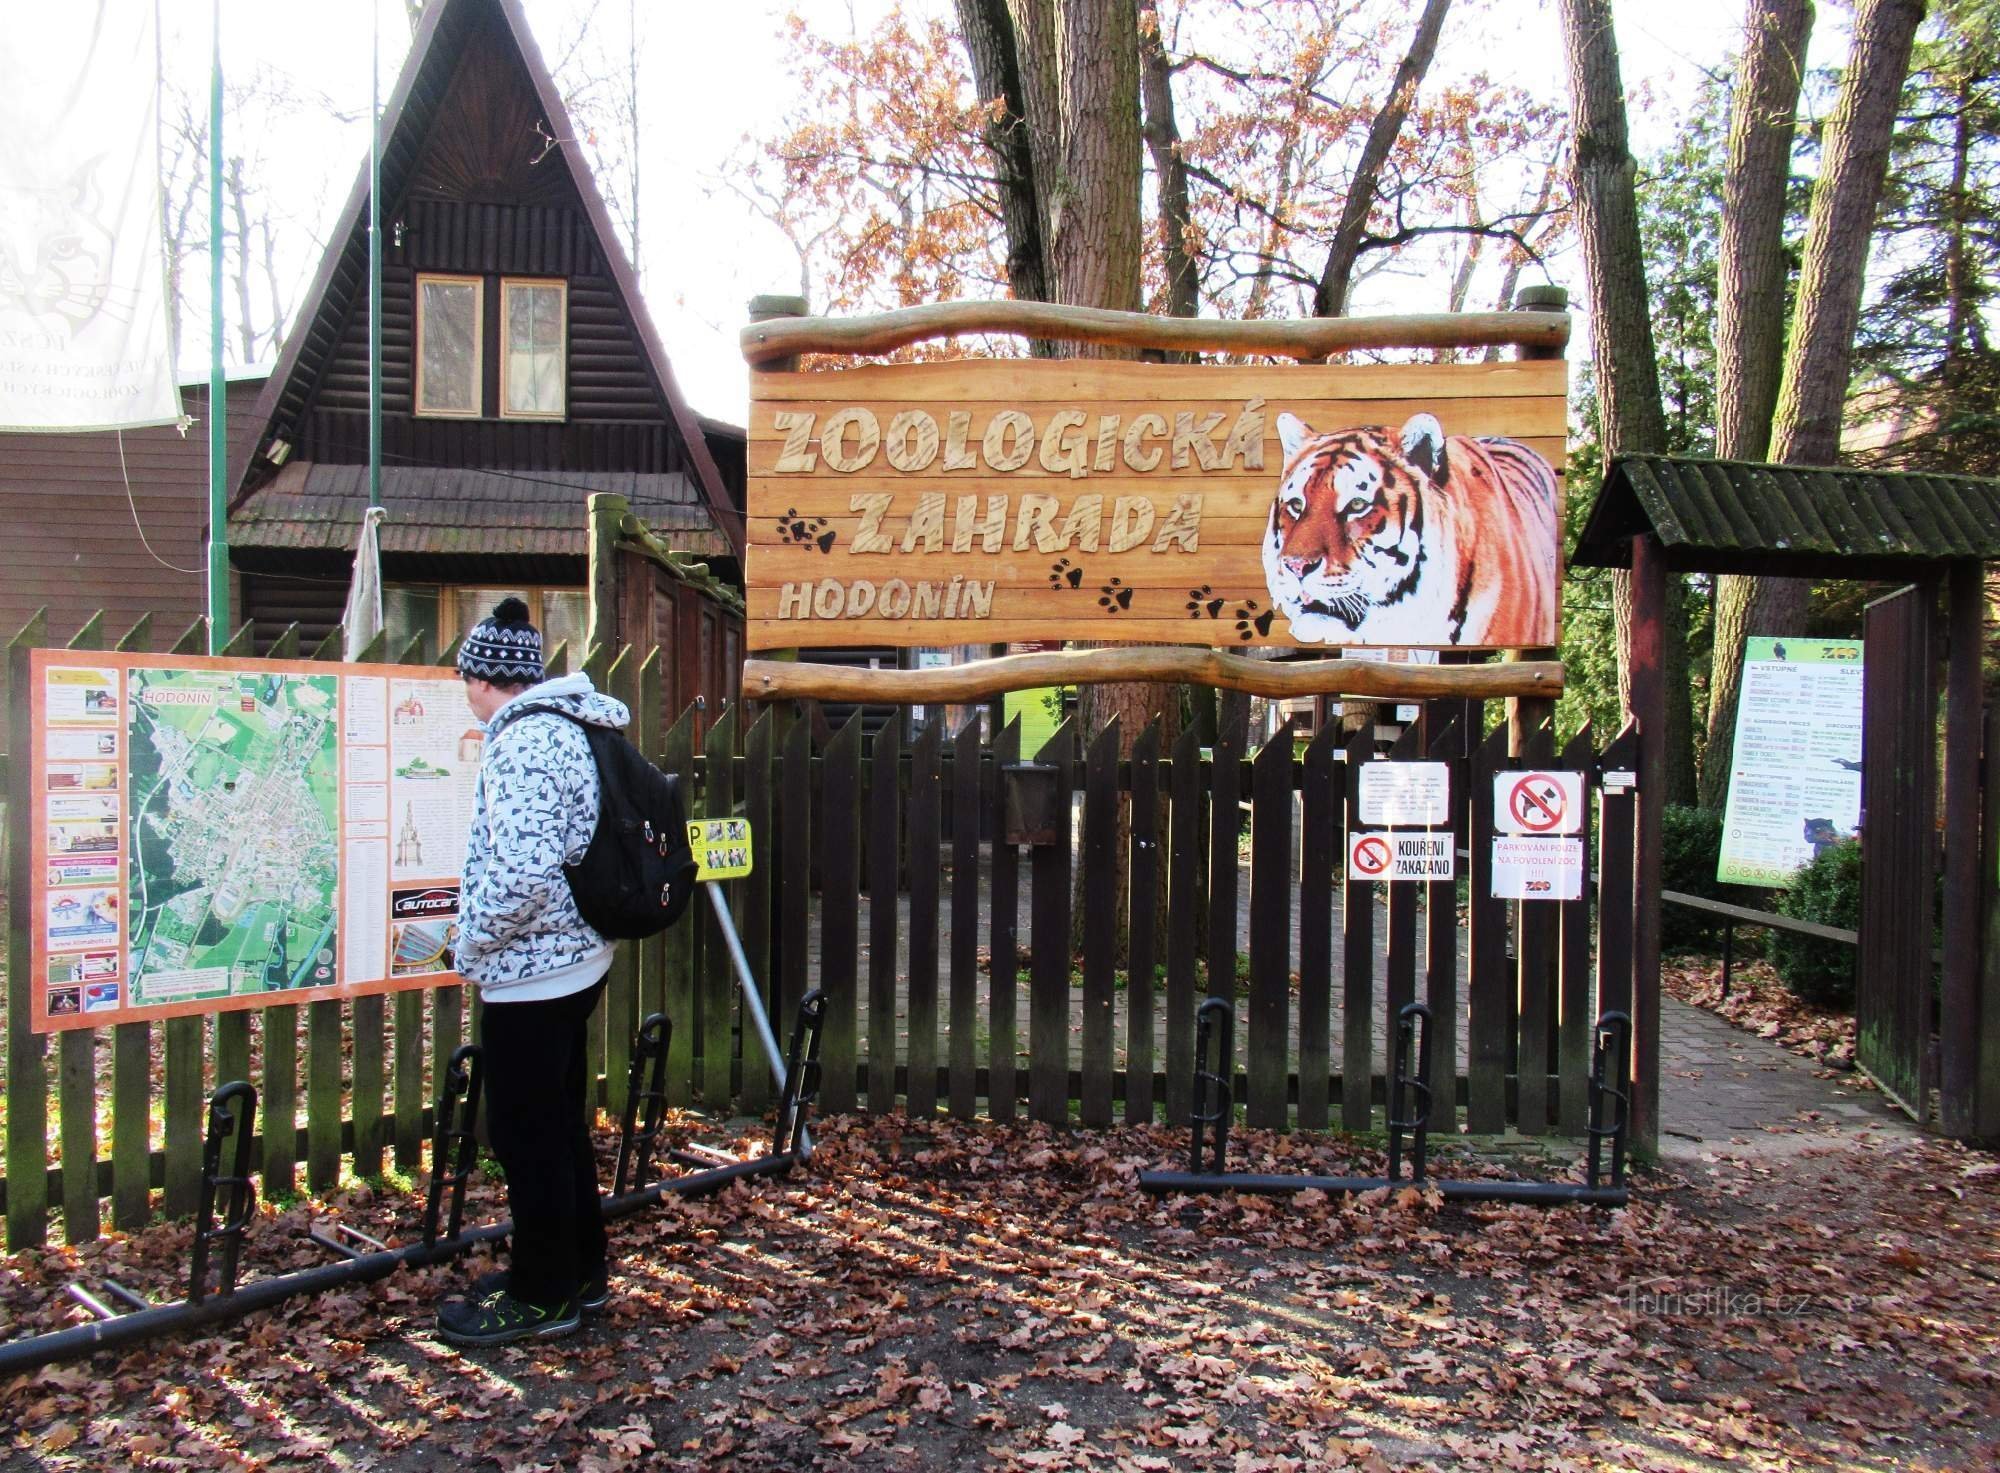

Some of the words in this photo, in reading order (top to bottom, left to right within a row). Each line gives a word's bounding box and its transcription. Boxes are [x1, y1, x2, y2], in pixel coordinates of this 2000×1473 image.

[774, 396, 1266, 479] ZOOLOGICKÁ
[848, 491, 1203, 554] ZAHRADA
[778, 573, 996, 619] HODONÍN
[1398, 838, 1445, 856] KOUŘENÍ
[1497, 856, 1512, 864] NA
[1558, 857, 1577, 865] ZOO
[1551, 844, 1579, 852] POUZE
